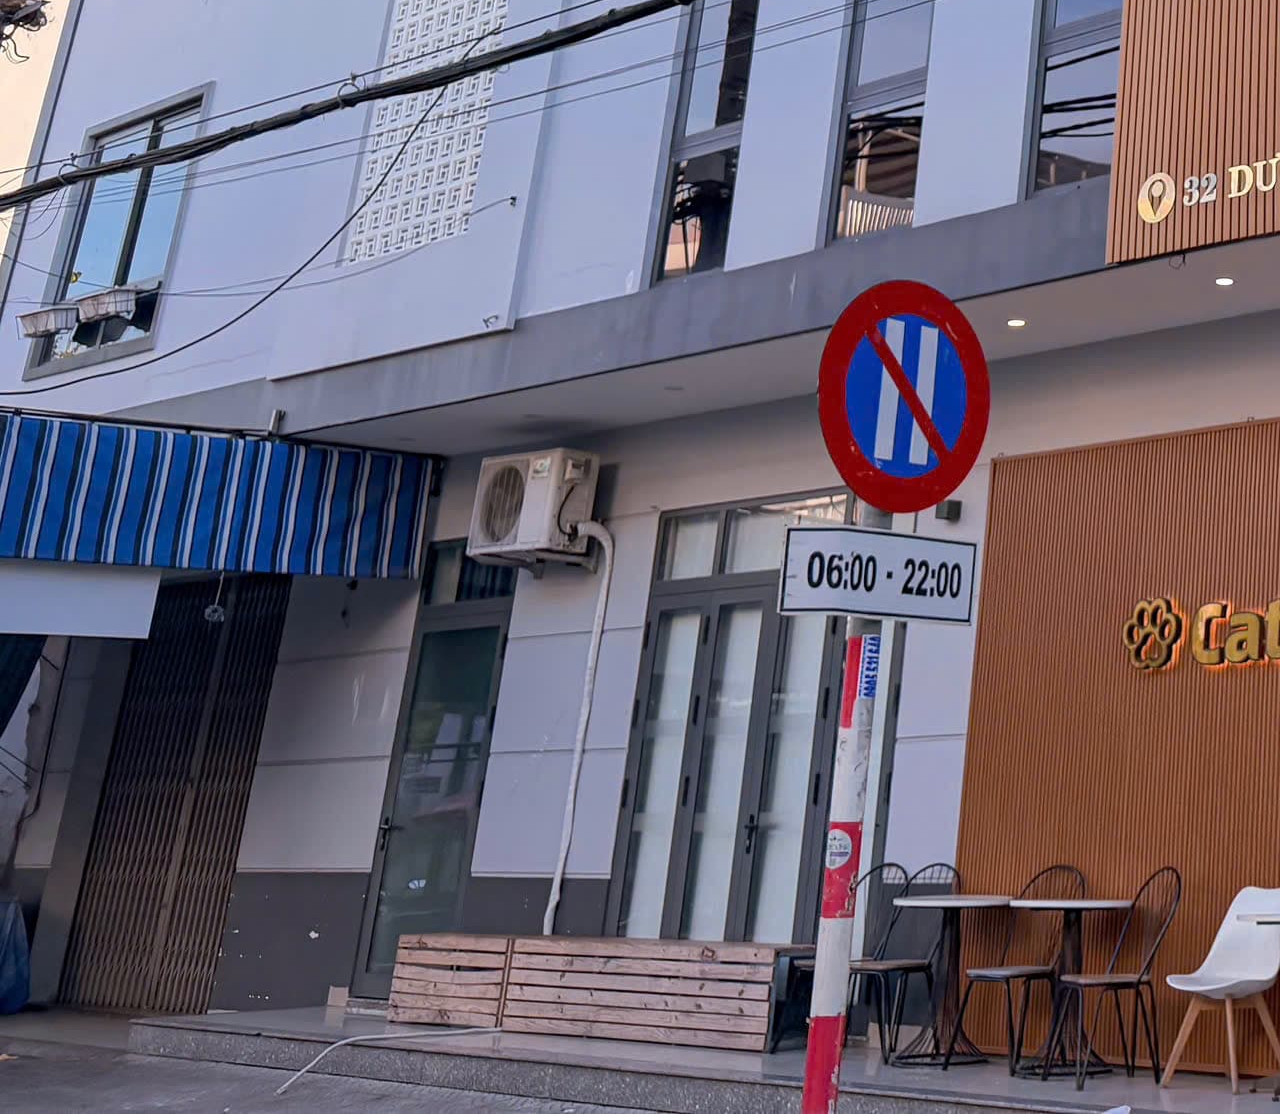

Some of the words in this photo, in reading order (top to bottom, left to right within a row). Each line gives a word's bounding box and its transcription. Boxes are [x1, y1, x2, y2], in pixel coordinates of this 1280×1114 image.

[1183, 173, 1217, 206] 32
[807, 551, 877, 592] 06:00
[901, 558, 962, 598] 22:00
